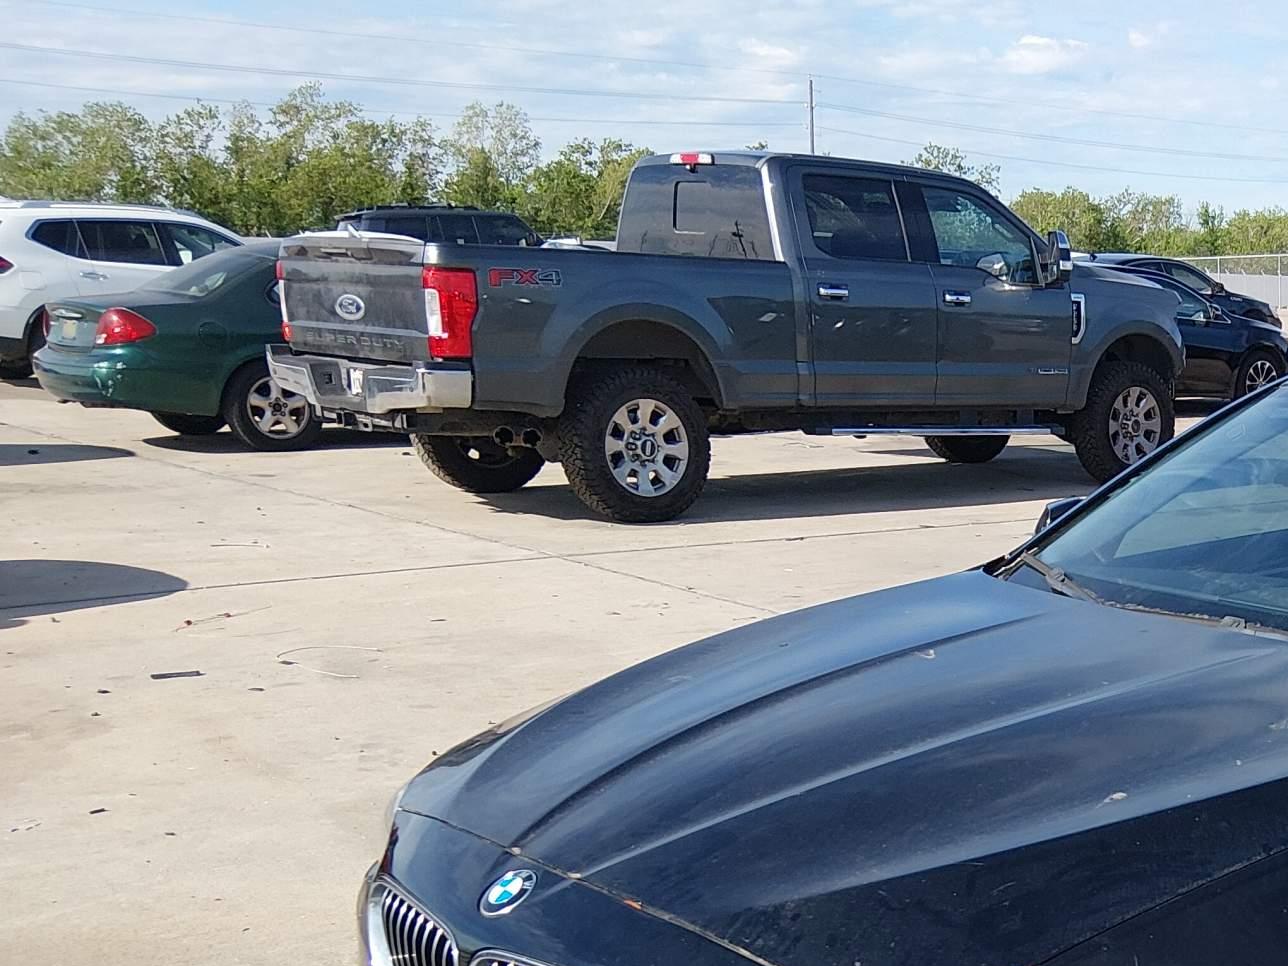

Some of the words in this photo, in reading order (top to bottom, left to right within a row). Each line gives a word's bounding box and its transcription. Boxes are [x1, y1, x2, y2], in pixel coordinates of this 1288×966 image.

[488, 267, 562, 288] FX4
[305, 327, 357, 345] SUPER
[359, 336, 402, 348] DUTY
